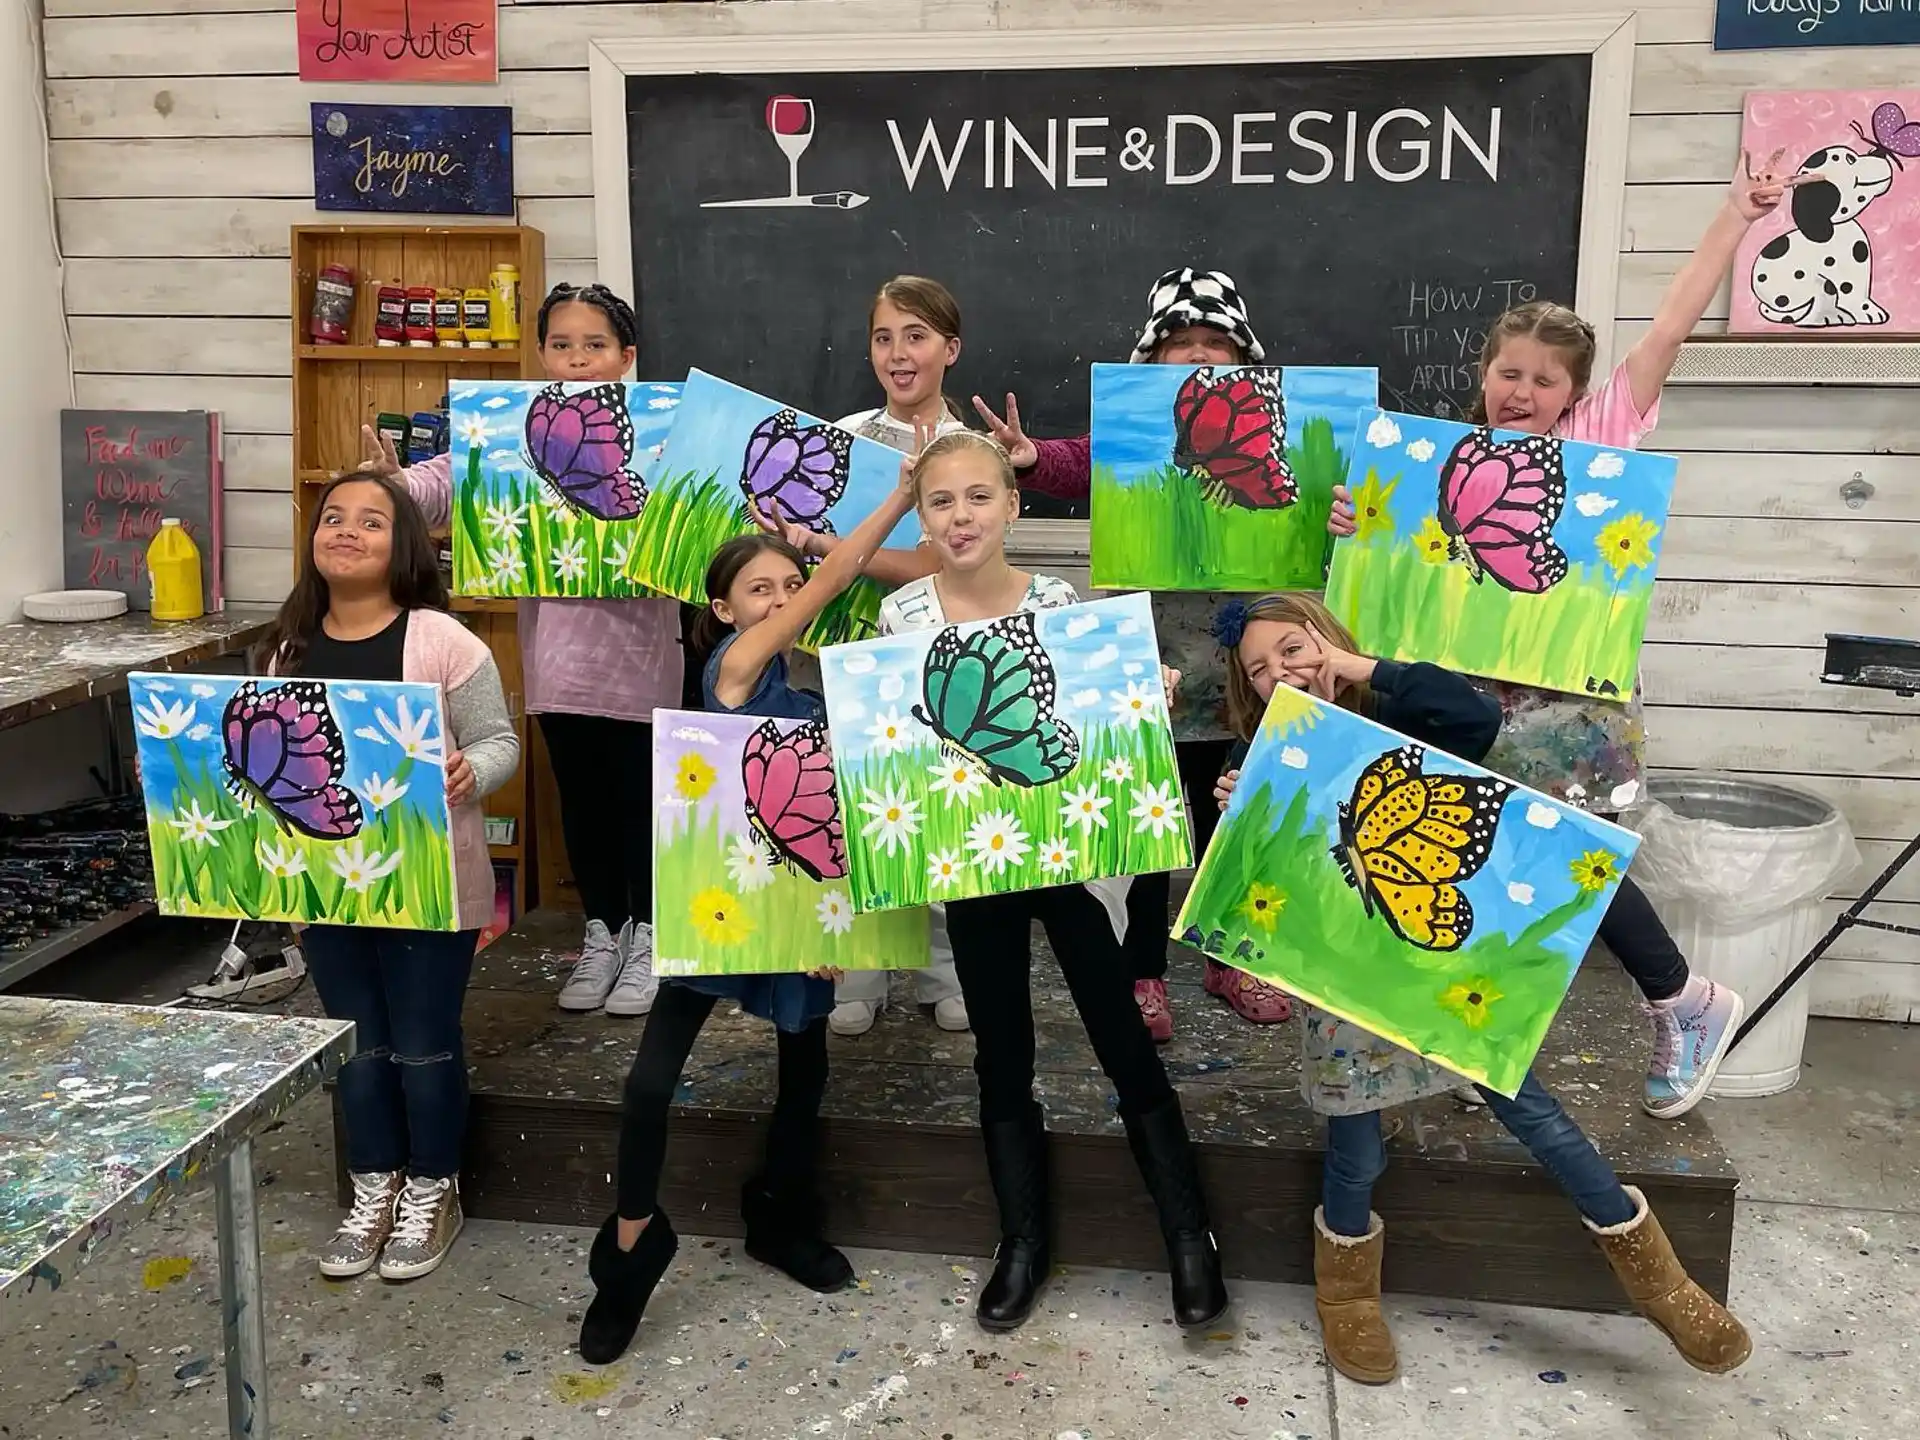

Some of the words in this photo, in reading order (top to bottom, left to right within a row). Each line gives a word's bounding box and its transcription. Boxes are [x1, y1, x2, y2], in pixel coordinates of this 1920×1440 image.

[316, 0, 380, 62] Your
[383, 0, 485, 60] Artist
[349, 136, 465, 198] Jayme
[1409, 281, 1483, 320] HOW
[1493, 279, 1537, 314] TO
[1392, 325, 1438, 357] TIP
[1453, 326, 1488, 359] YO
[96, 467, 190, 505] Wine
